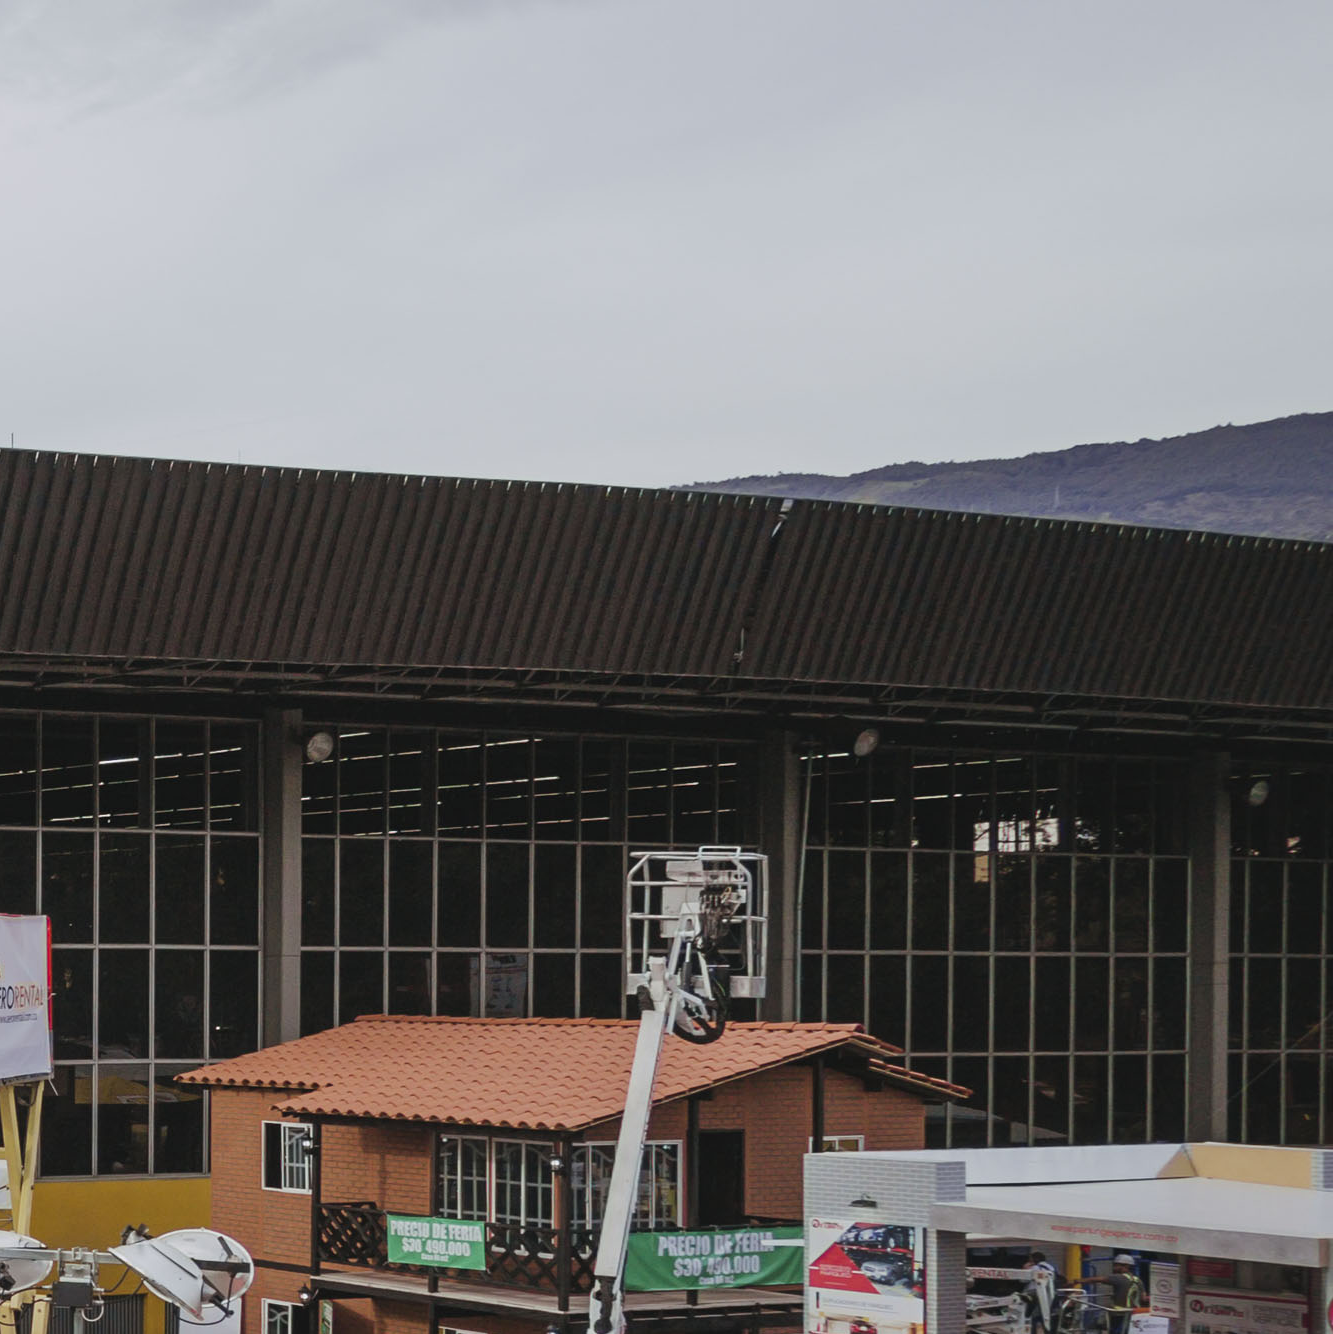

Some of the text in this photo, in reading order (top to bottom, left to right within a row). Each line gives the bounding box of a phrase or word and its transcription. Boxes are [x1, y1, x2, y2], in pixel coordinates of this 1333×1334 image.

[390, 1220, 483, 1243] PRECIO DE FERIA
[657, 1235, 711, 1257] PRECIO
[713, 1234, 733, 1255] DE
